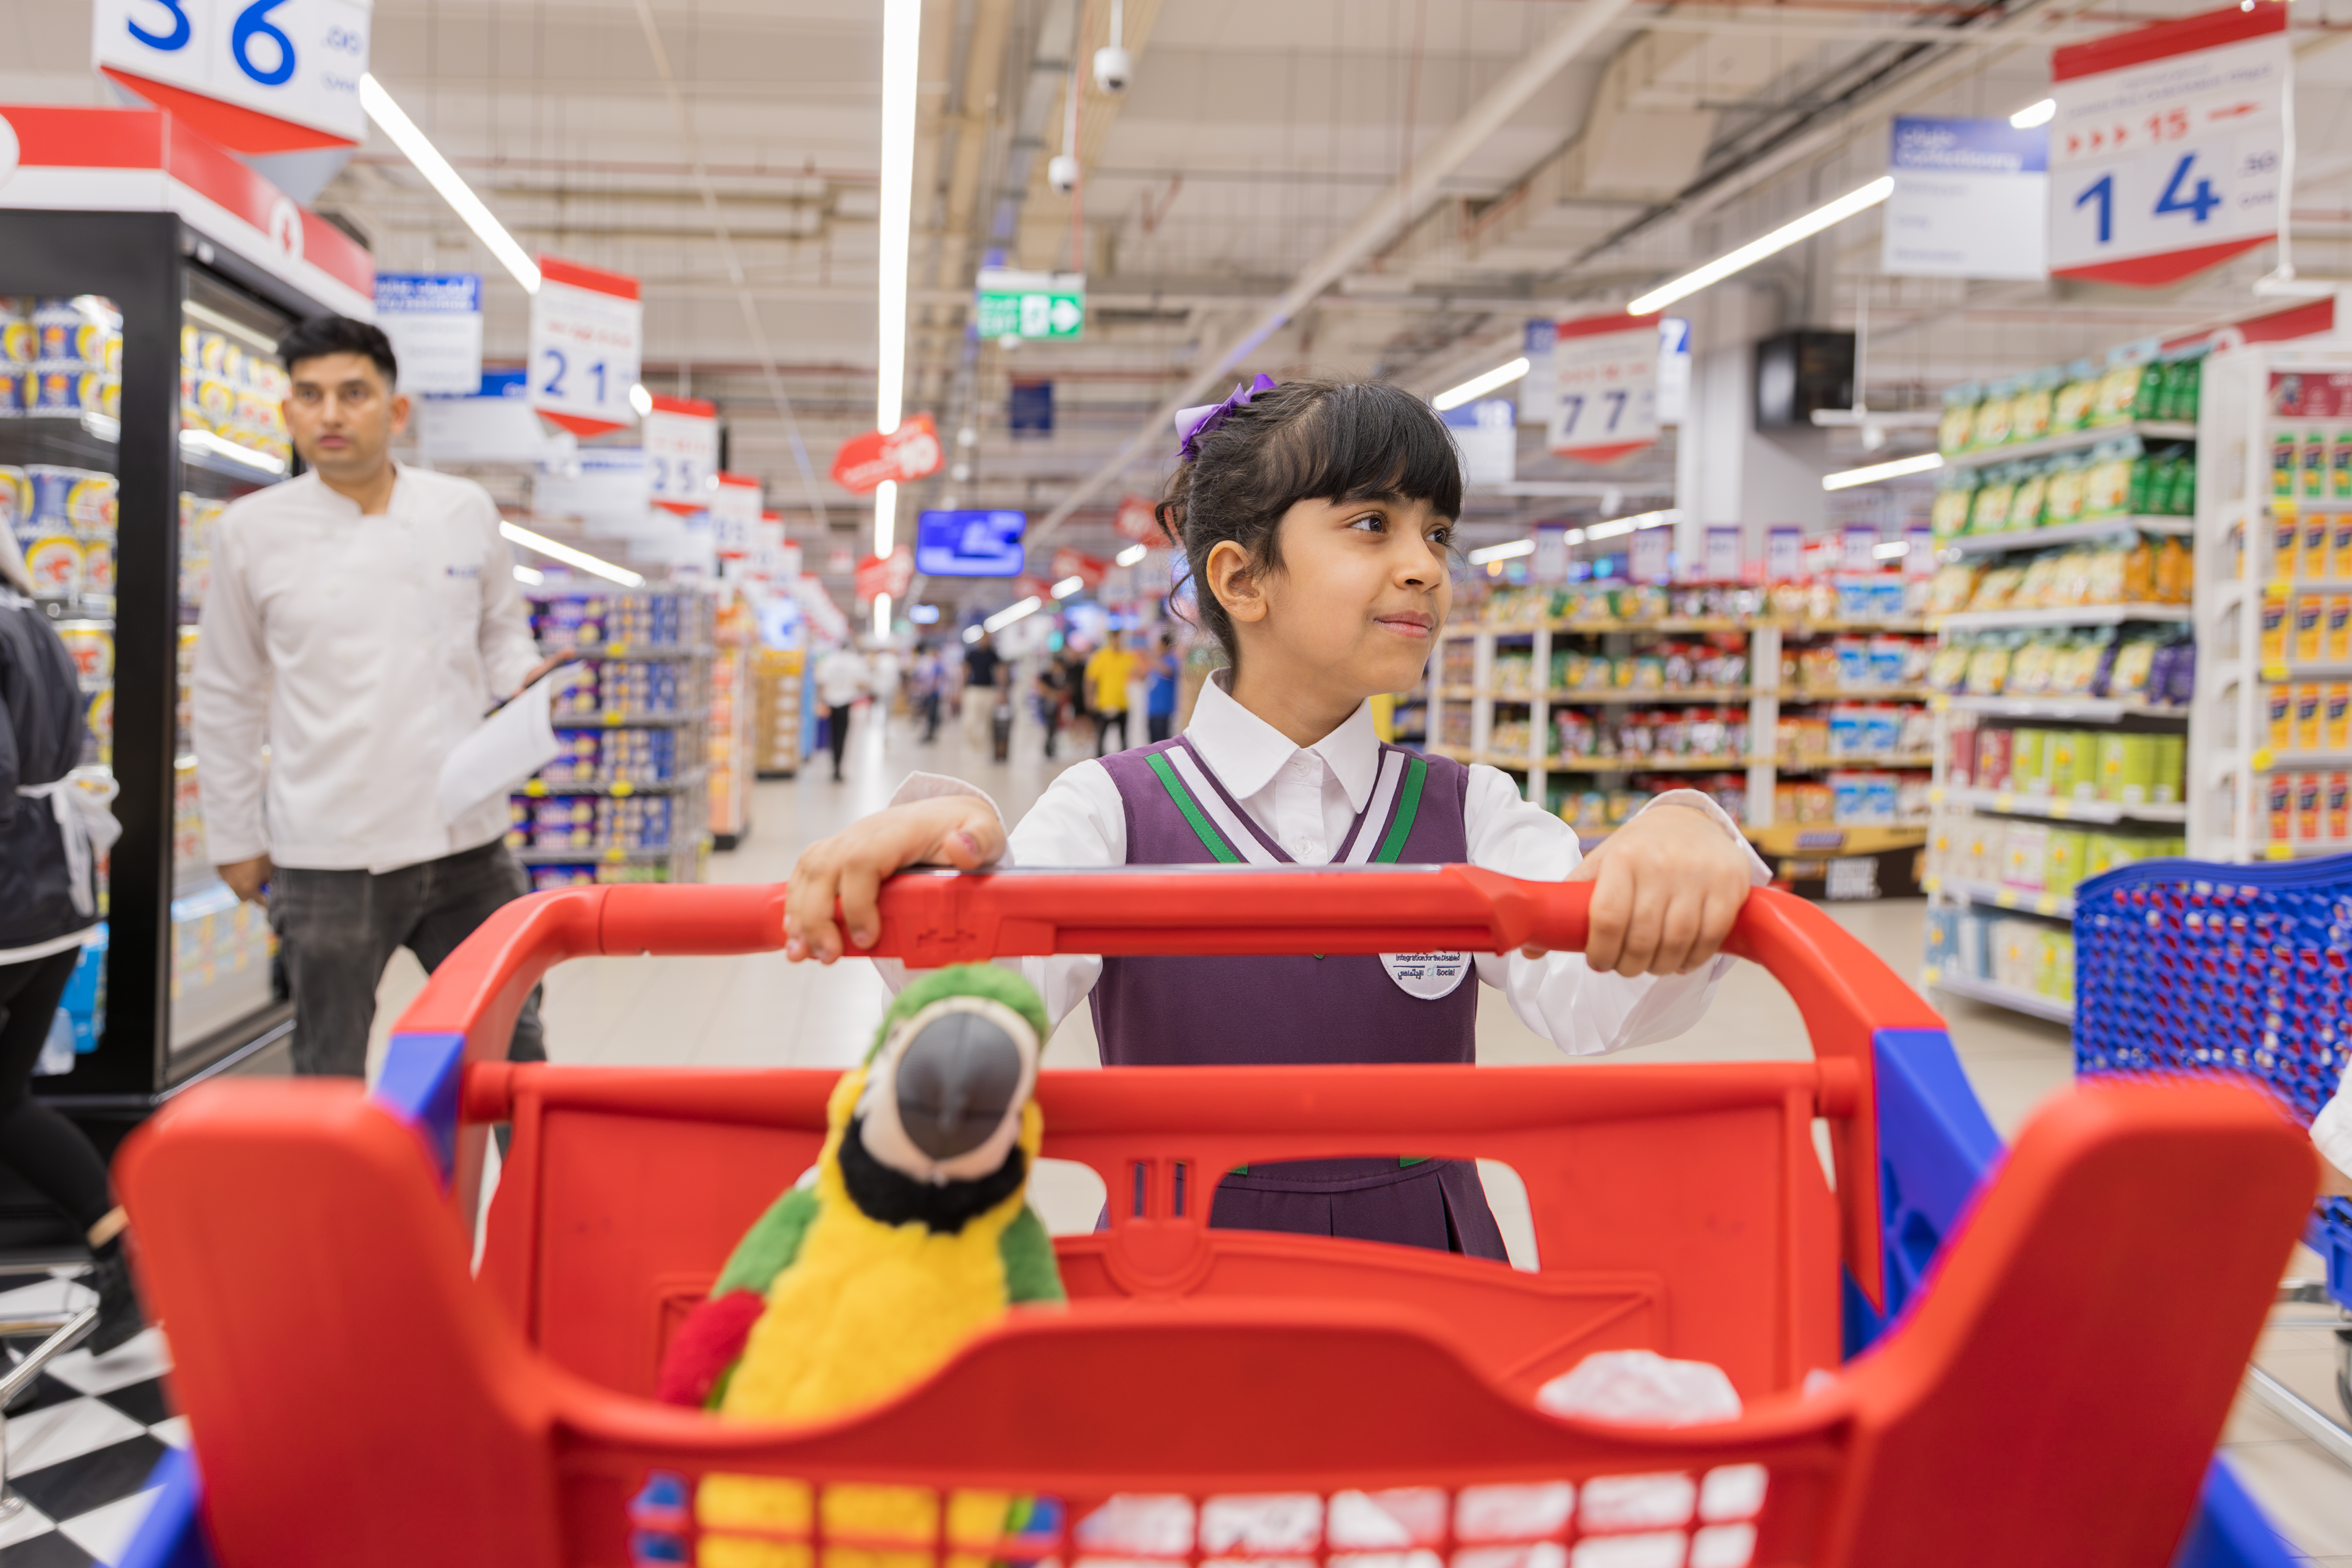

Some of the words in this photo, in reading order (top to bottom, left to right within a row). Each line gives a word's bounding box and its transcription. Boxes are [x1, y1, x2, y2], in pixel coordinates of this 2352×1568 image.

[2074, 151, 2222, 244] 14
[539, 348, 608, 405] 21
[1560, 388, 1628, 437] 77
[1396, 954, 1425, 962] Integration
